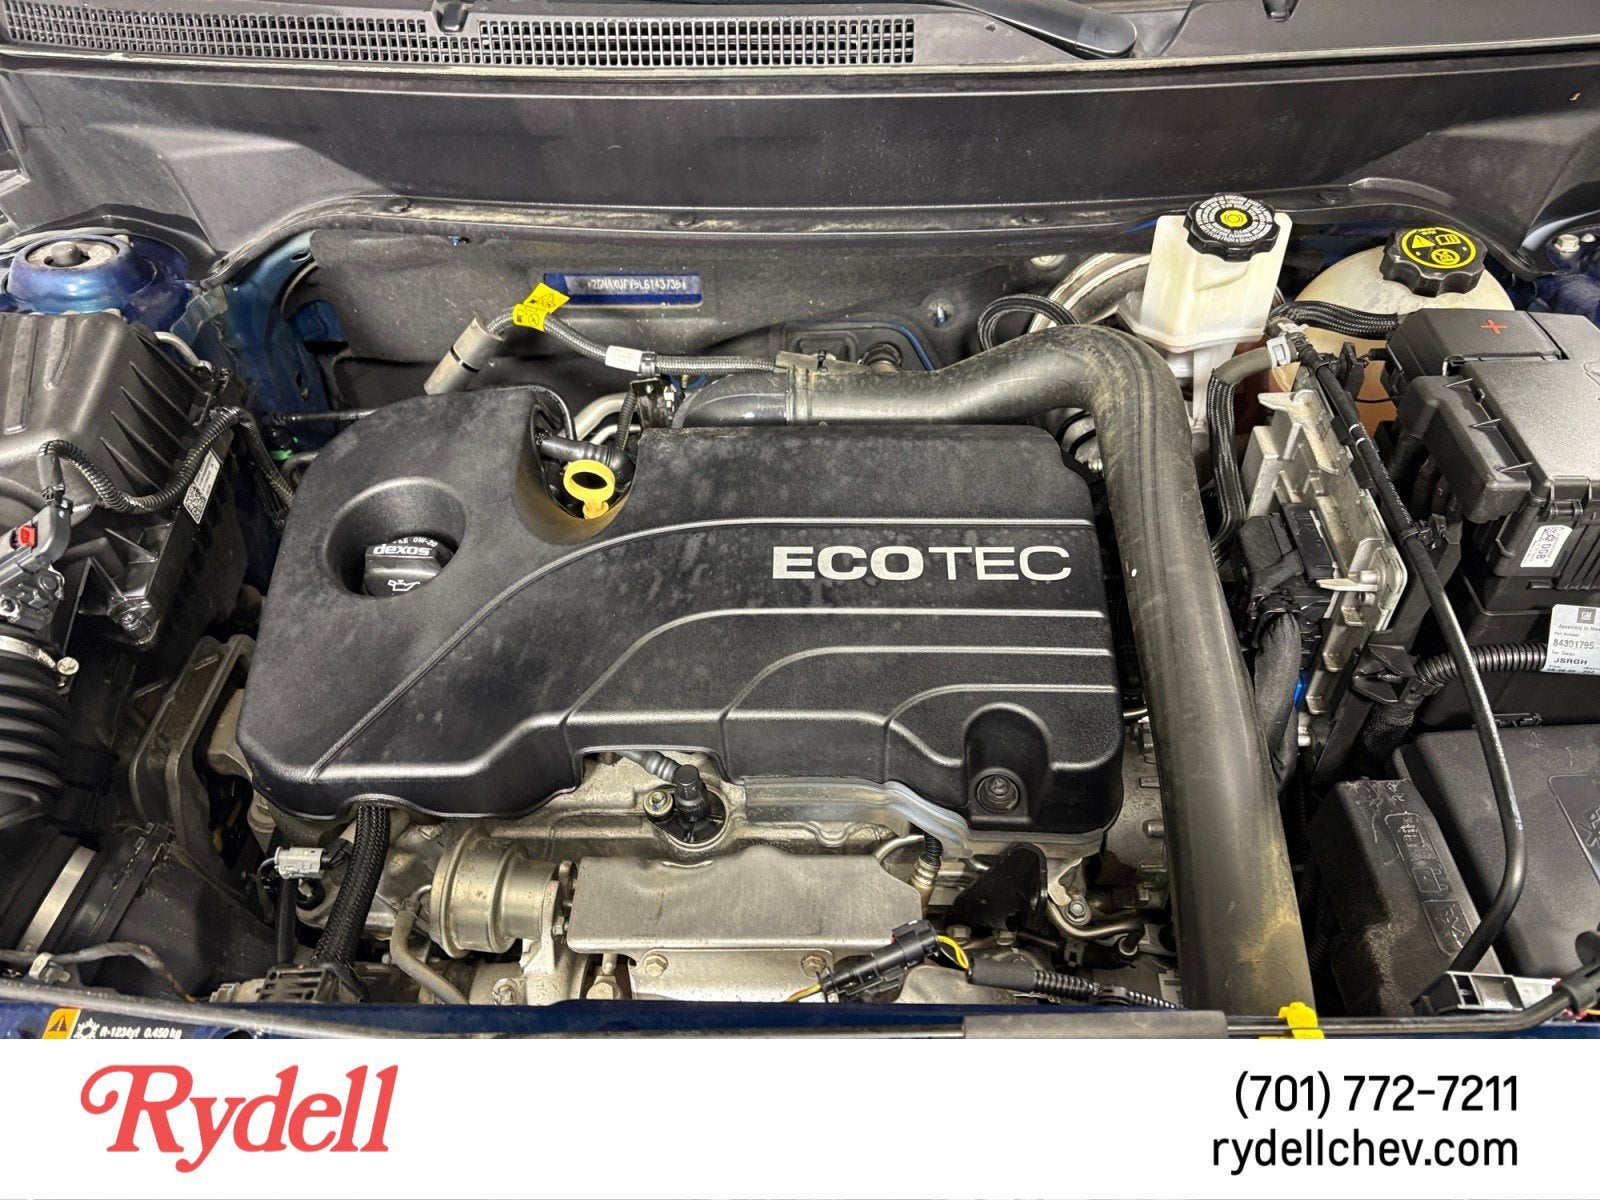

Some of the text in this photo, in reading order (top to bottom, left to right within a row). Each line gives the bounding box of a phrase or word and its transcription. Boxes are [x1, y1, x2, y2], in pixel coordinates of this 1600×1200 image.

[413, 537, 438, 547] 0W-20
[373, 543, 432, 556] dexos
[773, 546, 1072, 581] ECOTEC
[169, 1027, 183, 1039] kg
